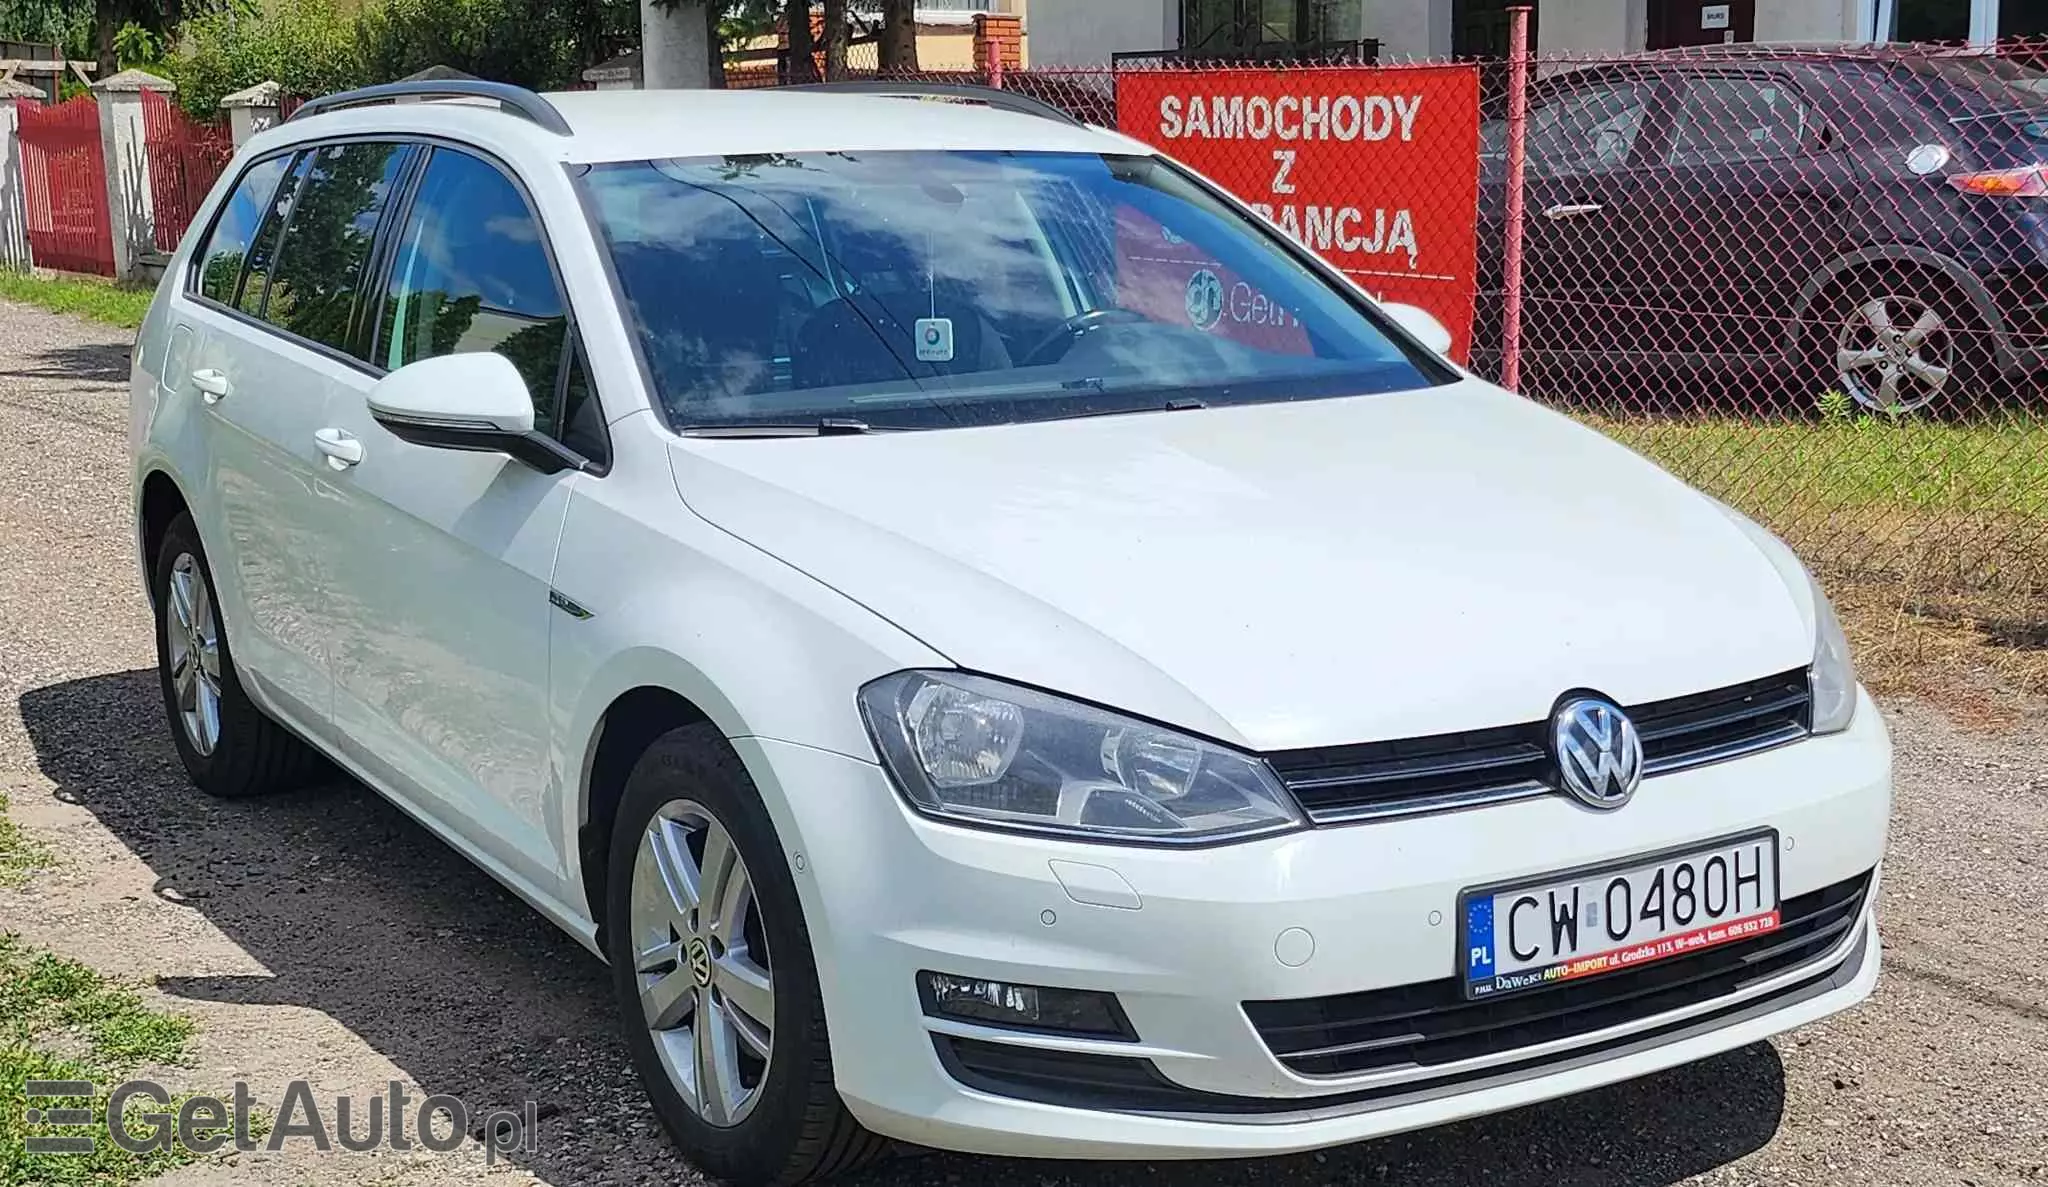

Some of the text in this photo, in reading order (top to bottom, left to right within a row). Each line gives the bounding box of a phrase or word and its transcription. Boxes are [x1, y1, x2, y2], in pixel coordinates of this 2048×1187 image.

[1160, 95, 1424, 142] SAMOCHODY
[1271, 149, 1297, 195] Z
[1508, 846, 1762, 963] CW 0480H
[1471, 946, 1492, 967] PL
[1543, 956, 1609, 981] AUTO-IMPORT
[1609, 954, 1621, 967] ul.
[1621, 944, 1656, 963] Grodzka
